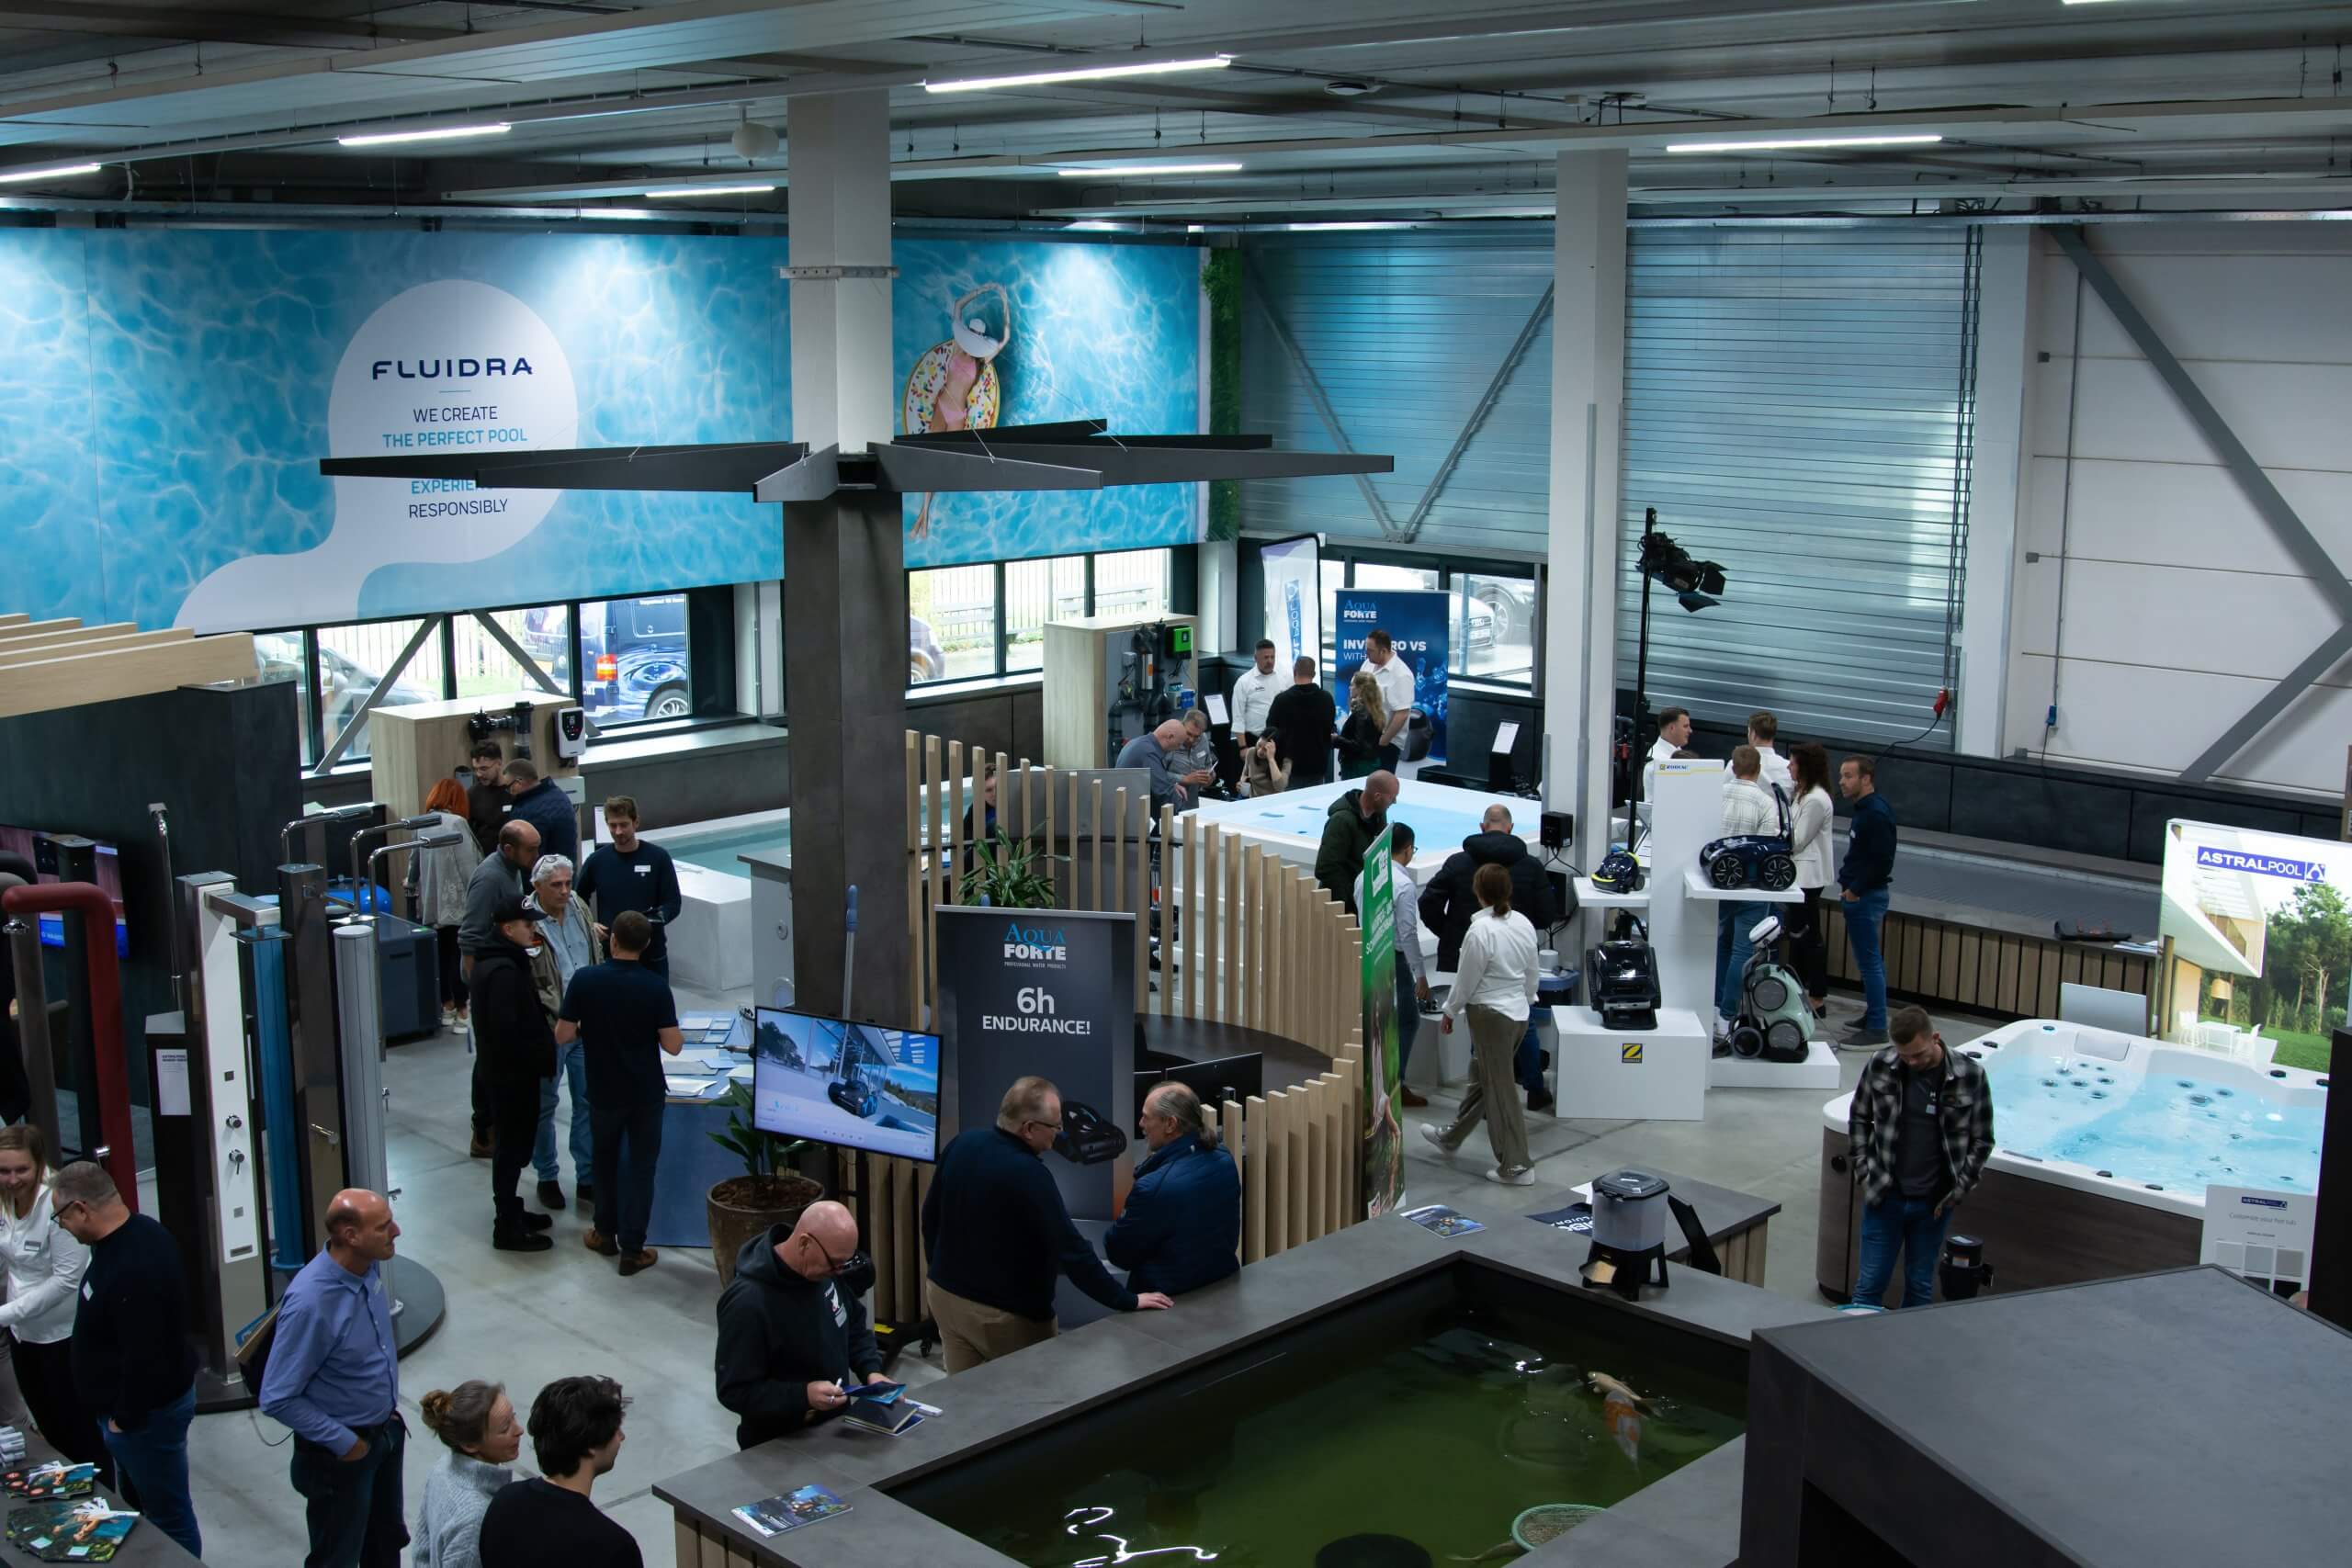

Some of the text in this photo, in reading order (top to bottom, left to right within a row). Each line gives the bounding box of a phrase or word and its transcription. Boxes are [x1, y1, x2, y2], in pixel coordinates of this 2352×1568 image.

[372, 357, 533, 380] FLUIDRA
[413, 406, 498, 423] WE CREATE
[382, 428, 528, 448] THE PERFECT POOL
[411, 478, 493, 495] EXPERIE
[409, 499, 508, 519] RESPONSIBLY
[1344, 599, 1376, 610] AQUA
[1343, 610, 1377, 619] FORTE
[1409, 641, 1427, 651] VS
[1343, 652, 1367, 661] WITH
[2199, 851, 2303, 876] ASTRALPOOL
[1004, 923, 1066, 944] AQUA
[1003, 943, 1067, 961] FORTE
[1017, 987, 1055, 1014] 6h
[982, 1015, 1091, 1035] ENDURANCE!
